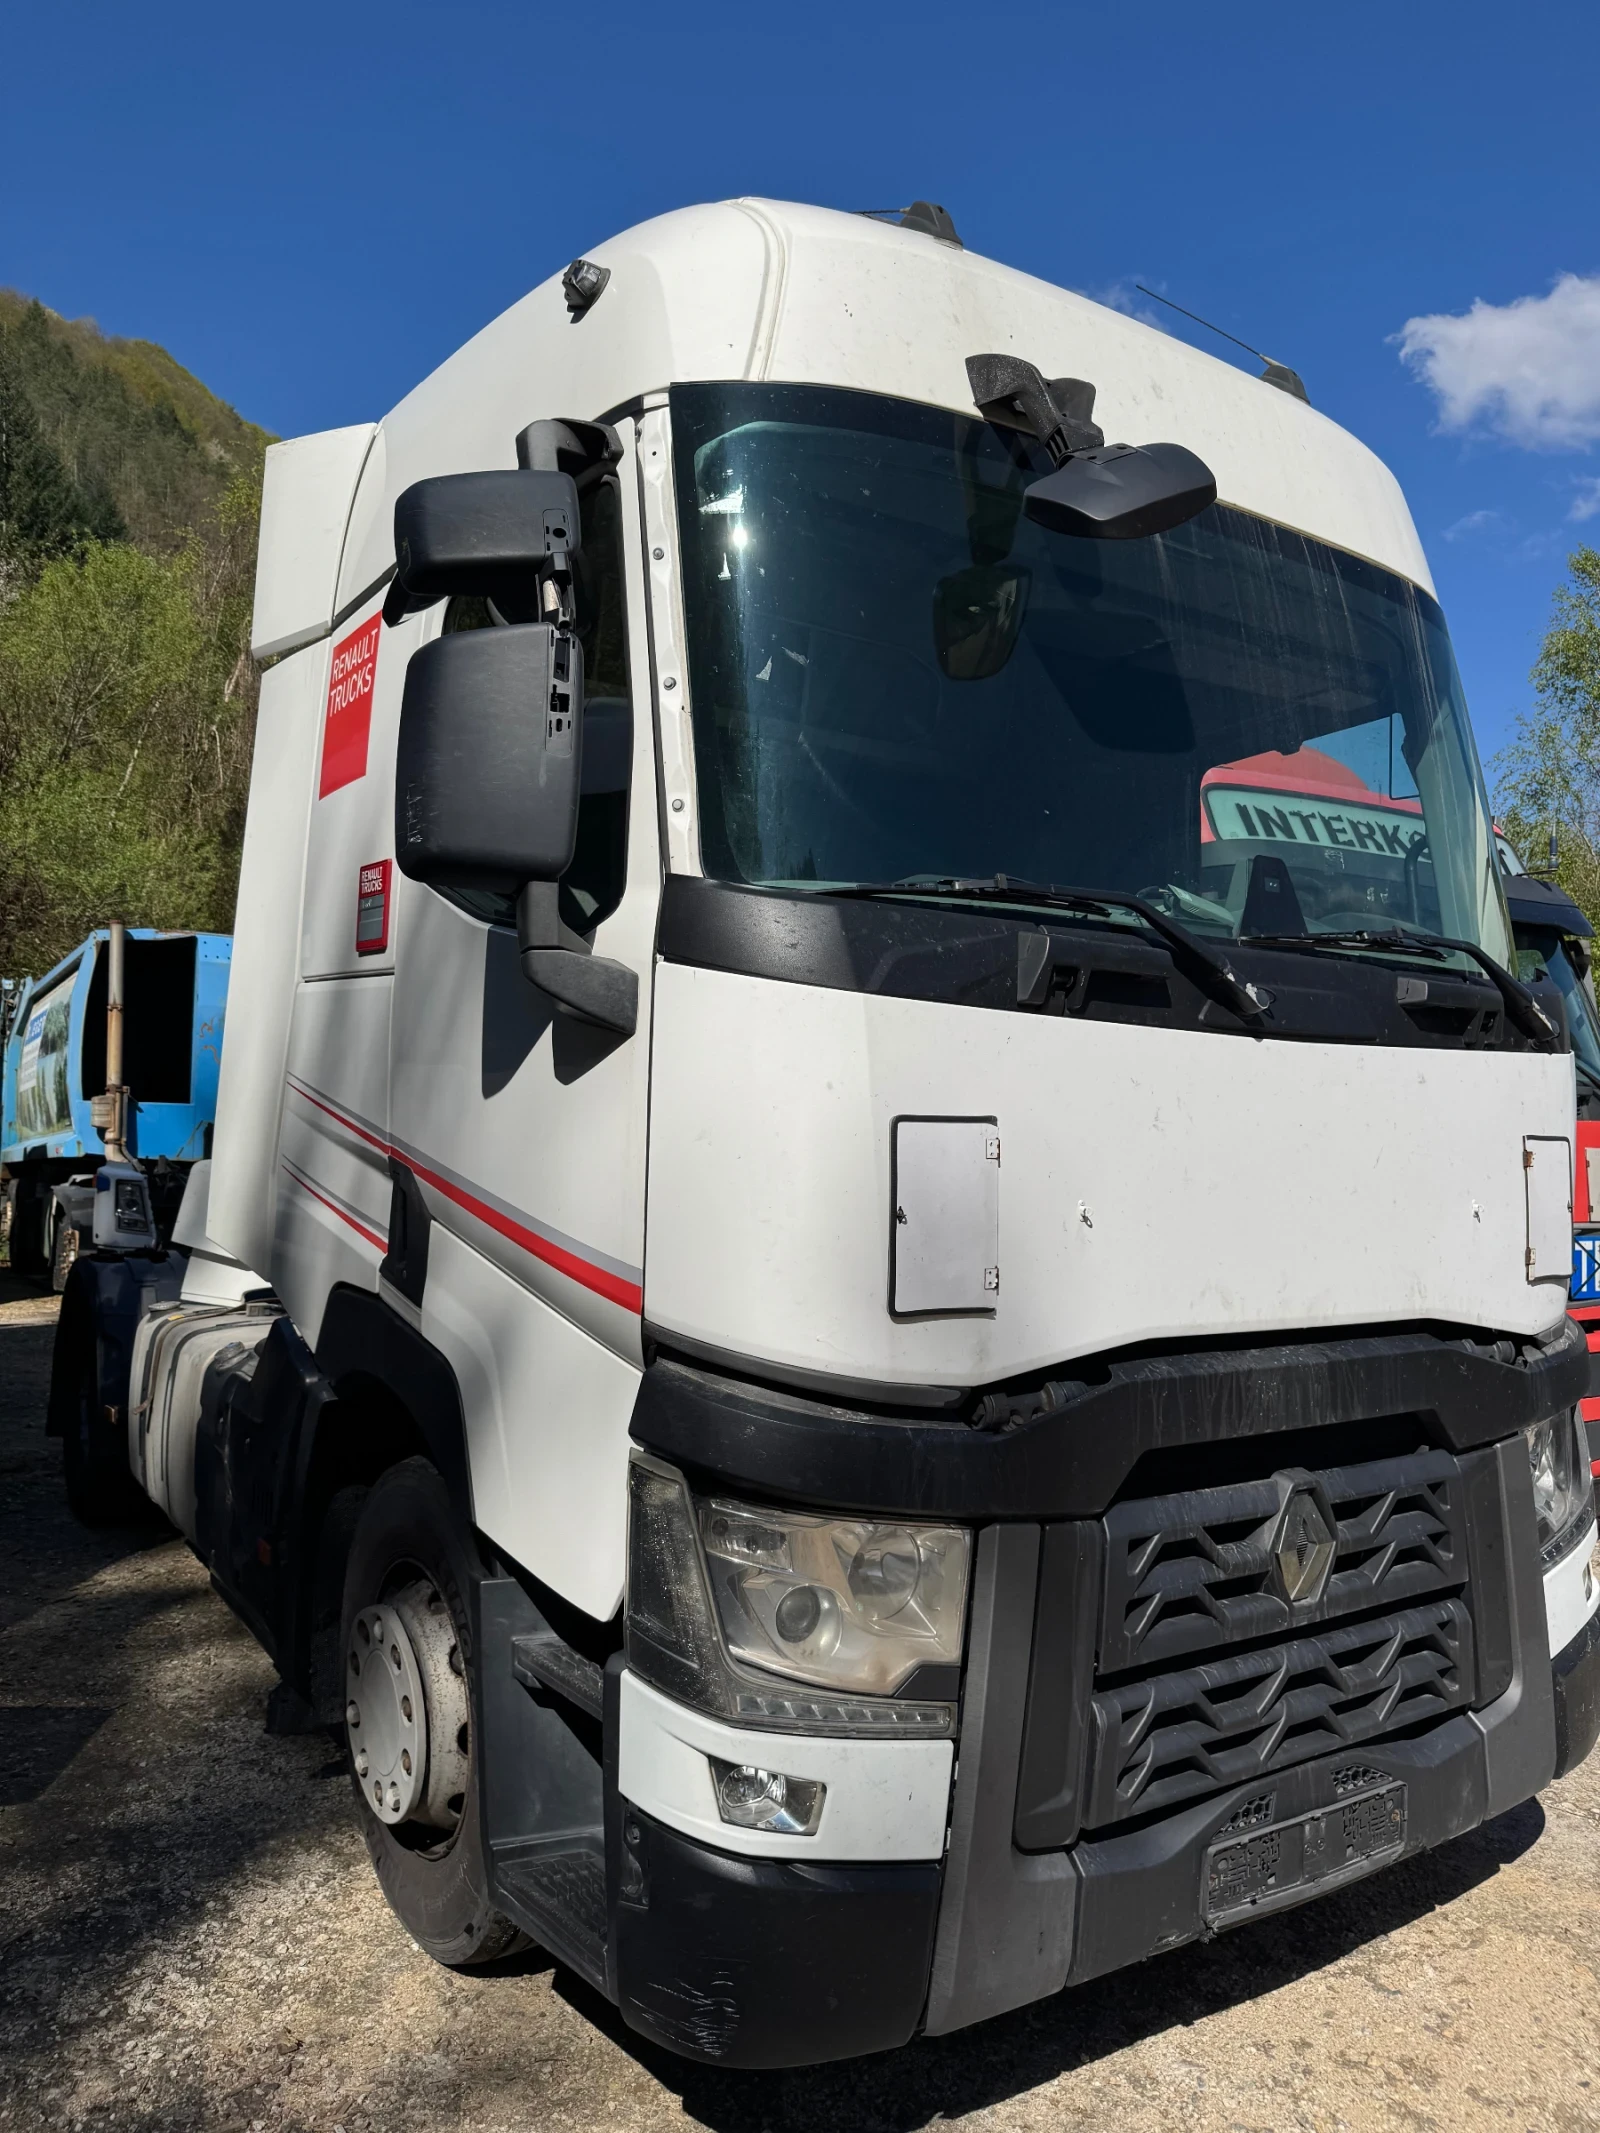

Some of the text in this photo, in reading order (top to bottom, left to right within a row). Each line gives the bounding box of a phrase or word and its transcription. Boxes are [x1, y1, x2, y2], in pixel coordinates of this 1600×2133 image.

[332, 628, 378, 684] RENAULT
[330, 663, 373, 717] TRUCKS
[361, 866, 383, 883] RENAULT
[361, 878, 383, 894] TRUCKS
